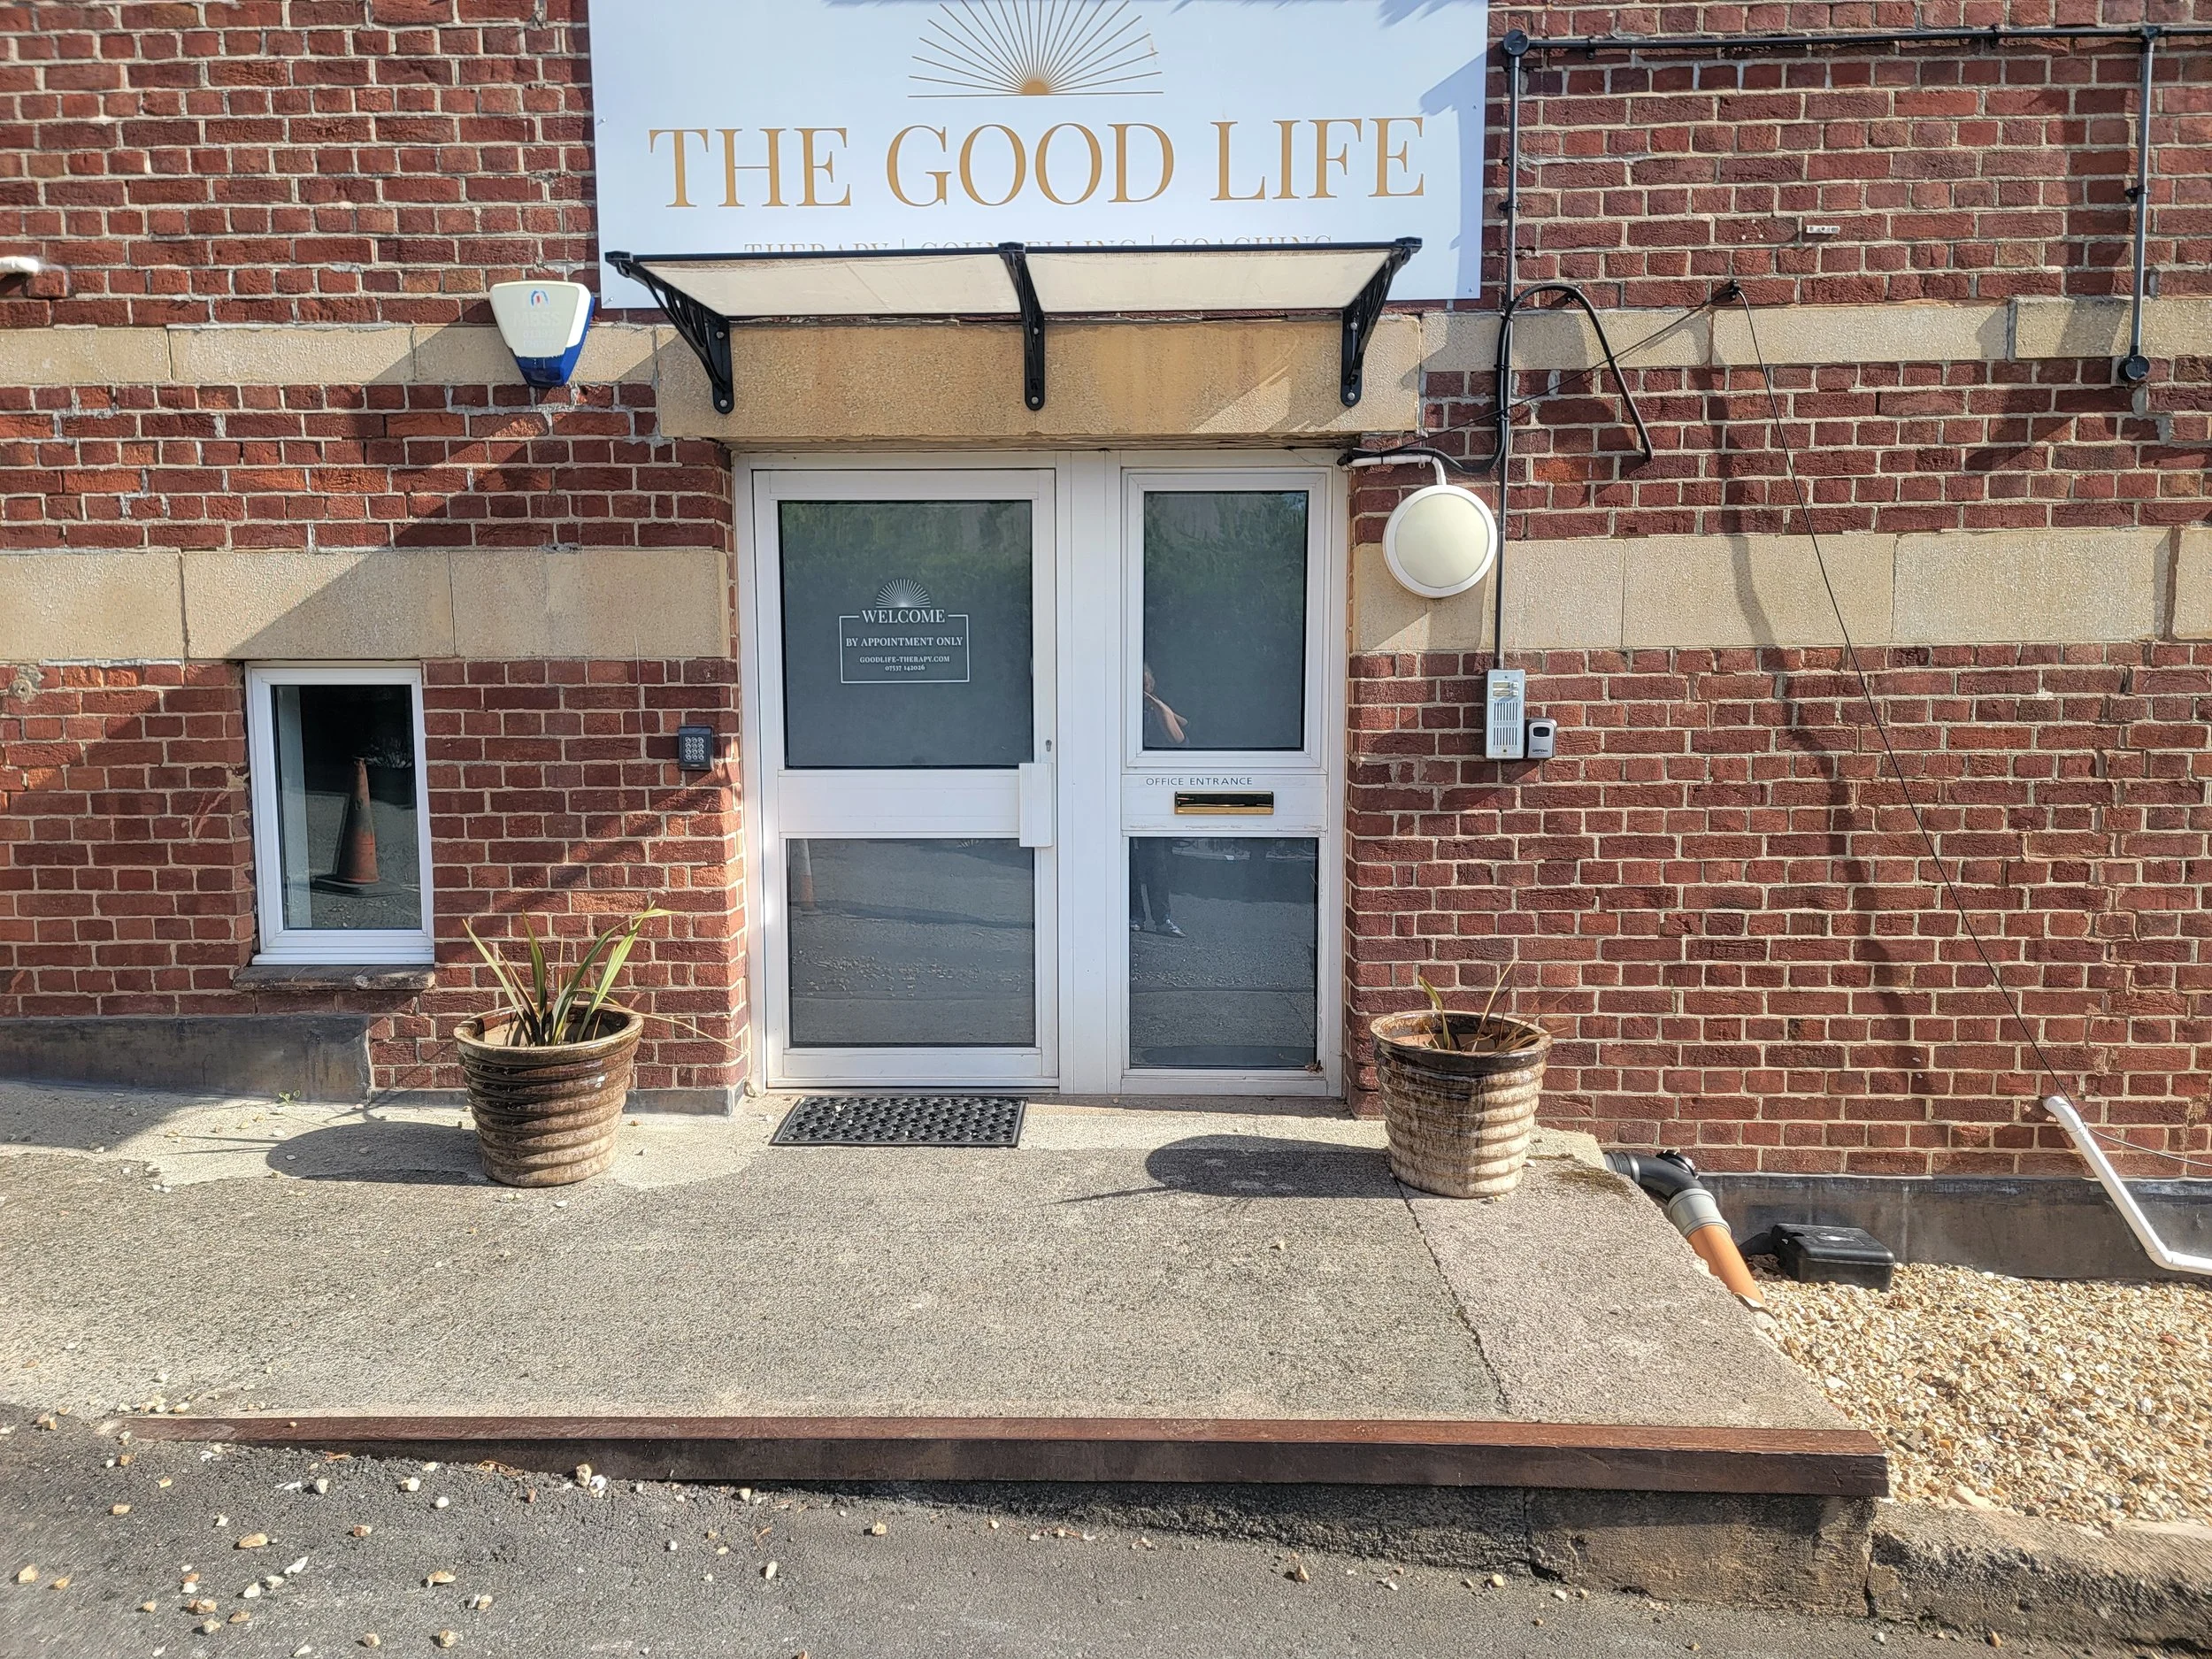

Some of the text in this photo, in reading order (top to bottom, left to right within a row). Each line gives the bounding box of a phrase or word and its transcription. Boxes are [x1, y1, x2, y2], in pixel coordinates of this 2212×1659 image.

[649, 117, 1425, 209] THE GOOD LIFE
[862, 609, 946, 624] WELCOME
[846, 636, 963, 647] BY APPOINTMENT ONLY
[1189, 777, 1253, 786] ENTRANCE
